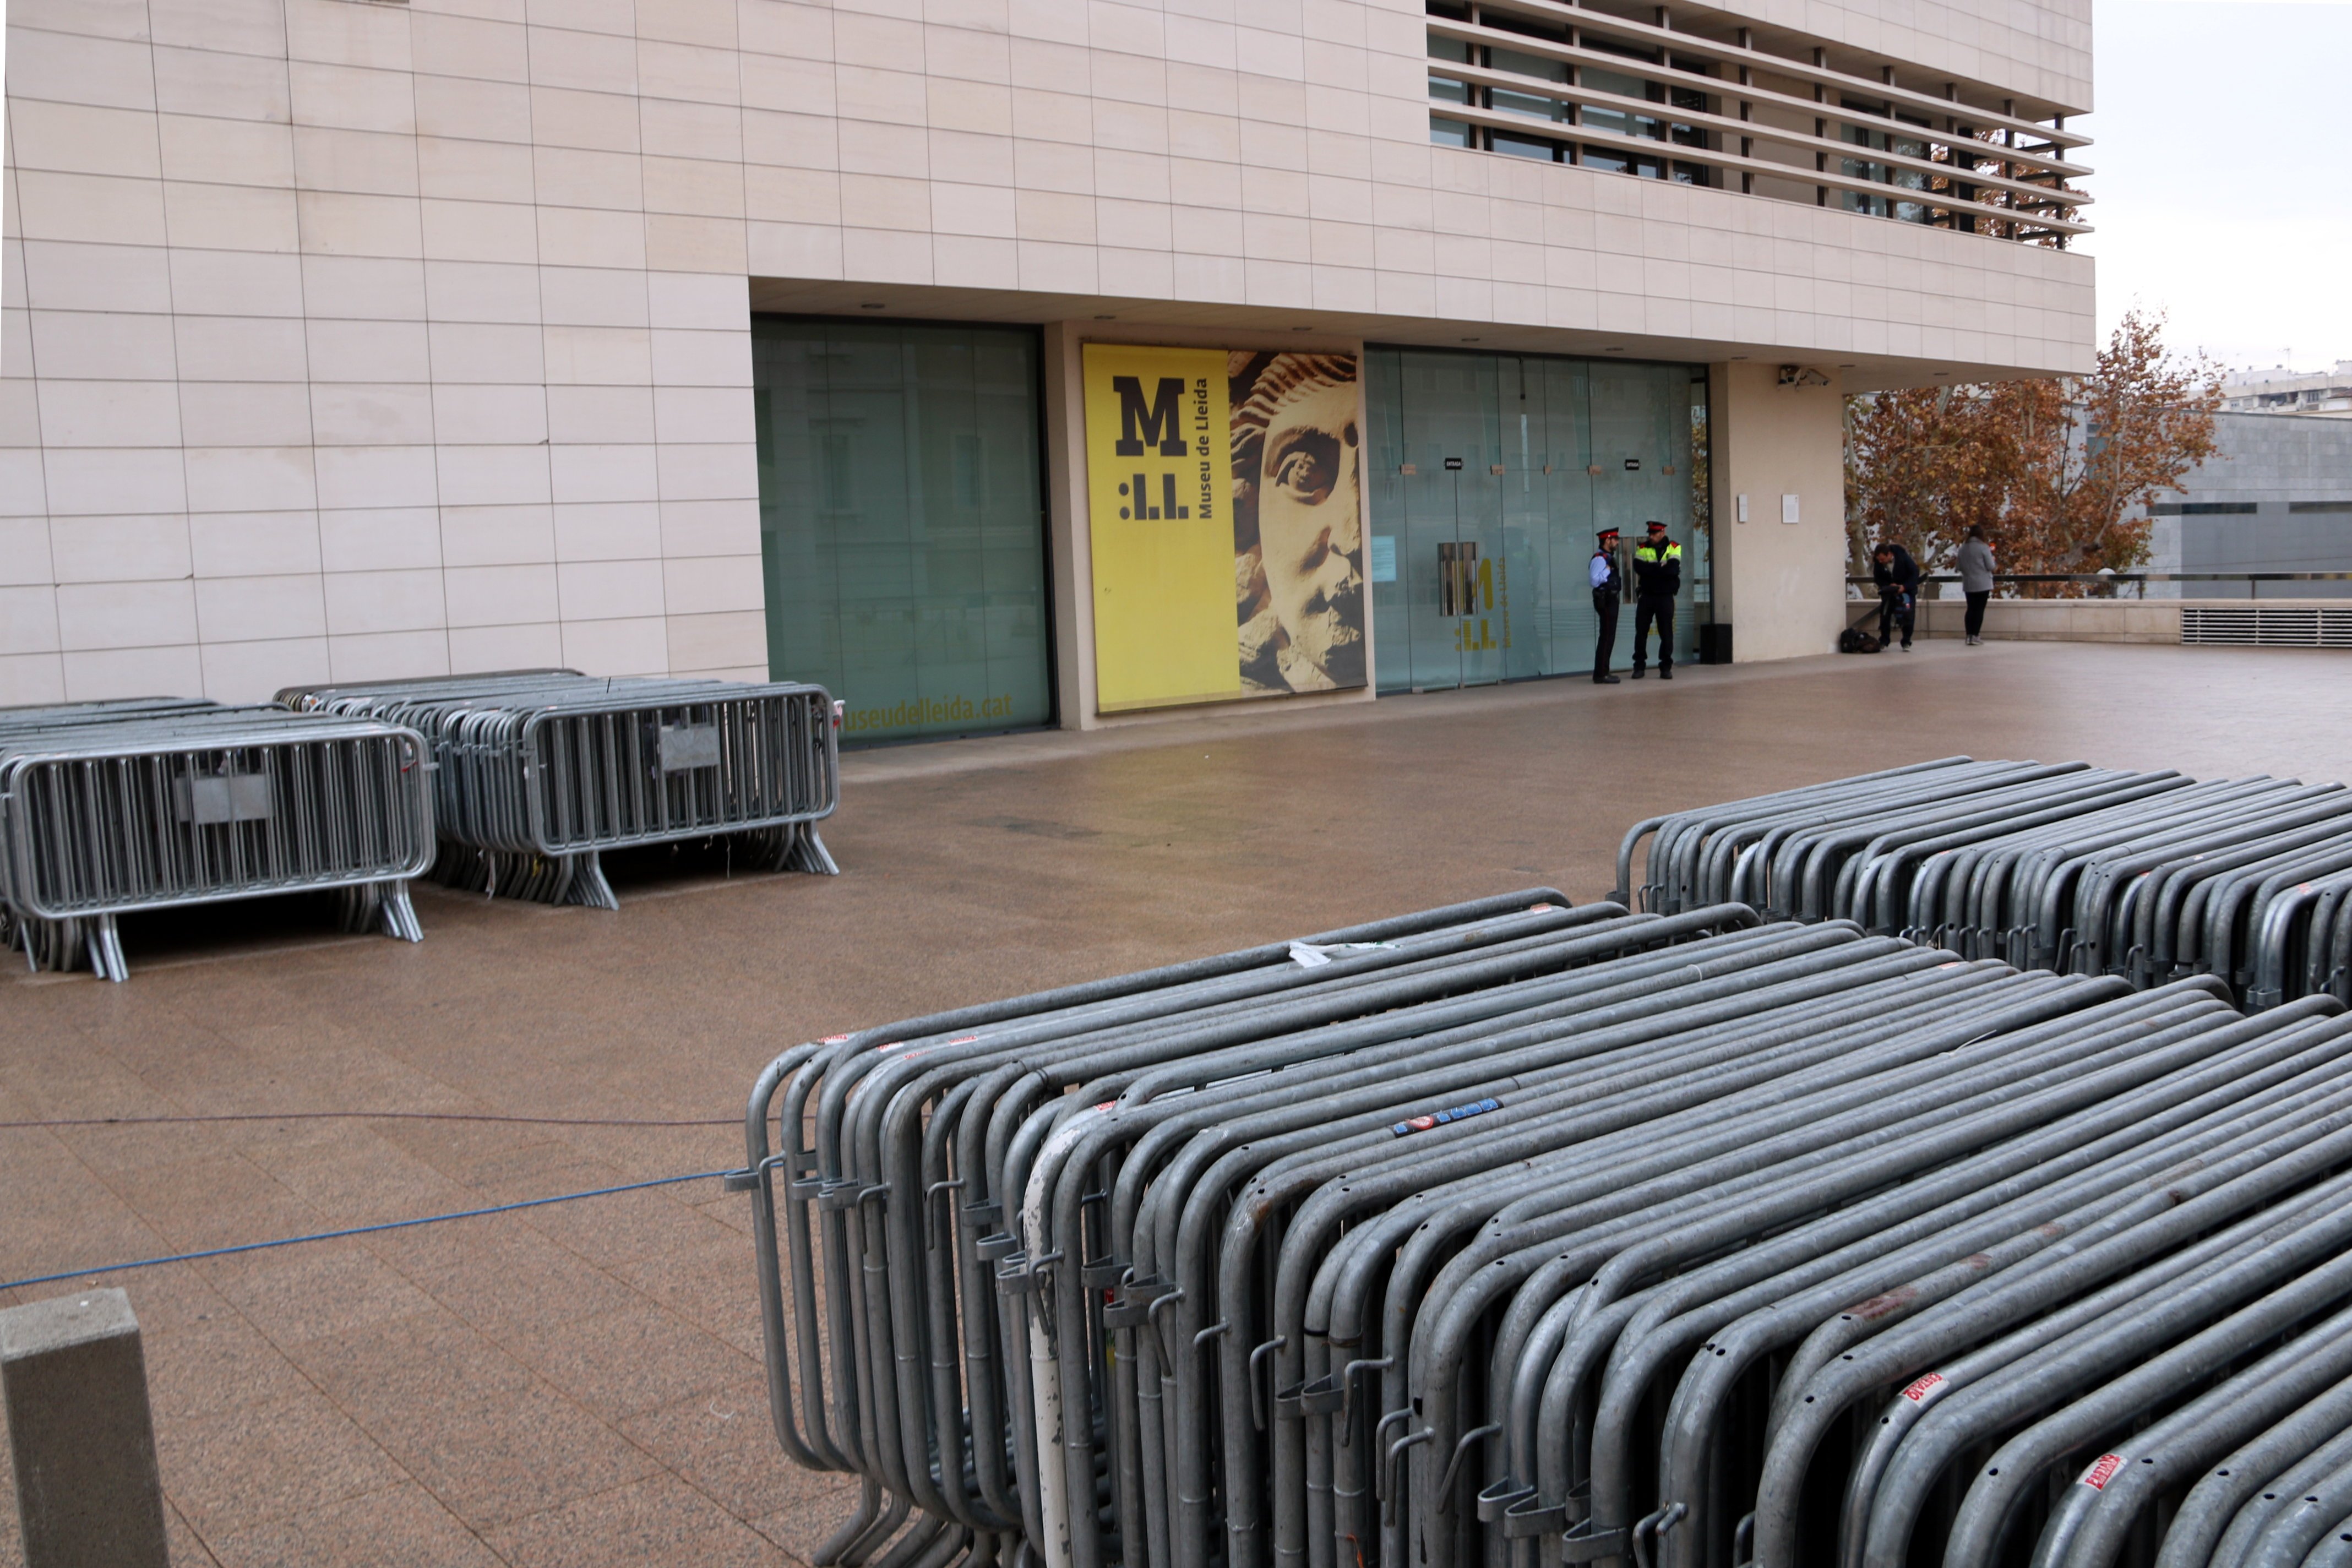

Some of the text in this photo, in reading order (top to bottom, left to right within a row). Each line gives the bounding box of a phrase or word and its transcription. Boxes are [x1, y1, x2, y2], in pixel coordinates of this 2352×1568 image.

[1113, 376, 1188, 456] M
[1193, 378, 1212, 519] Museu de Lleida
[839, 693, 1013, 732] useudelleida.cat
